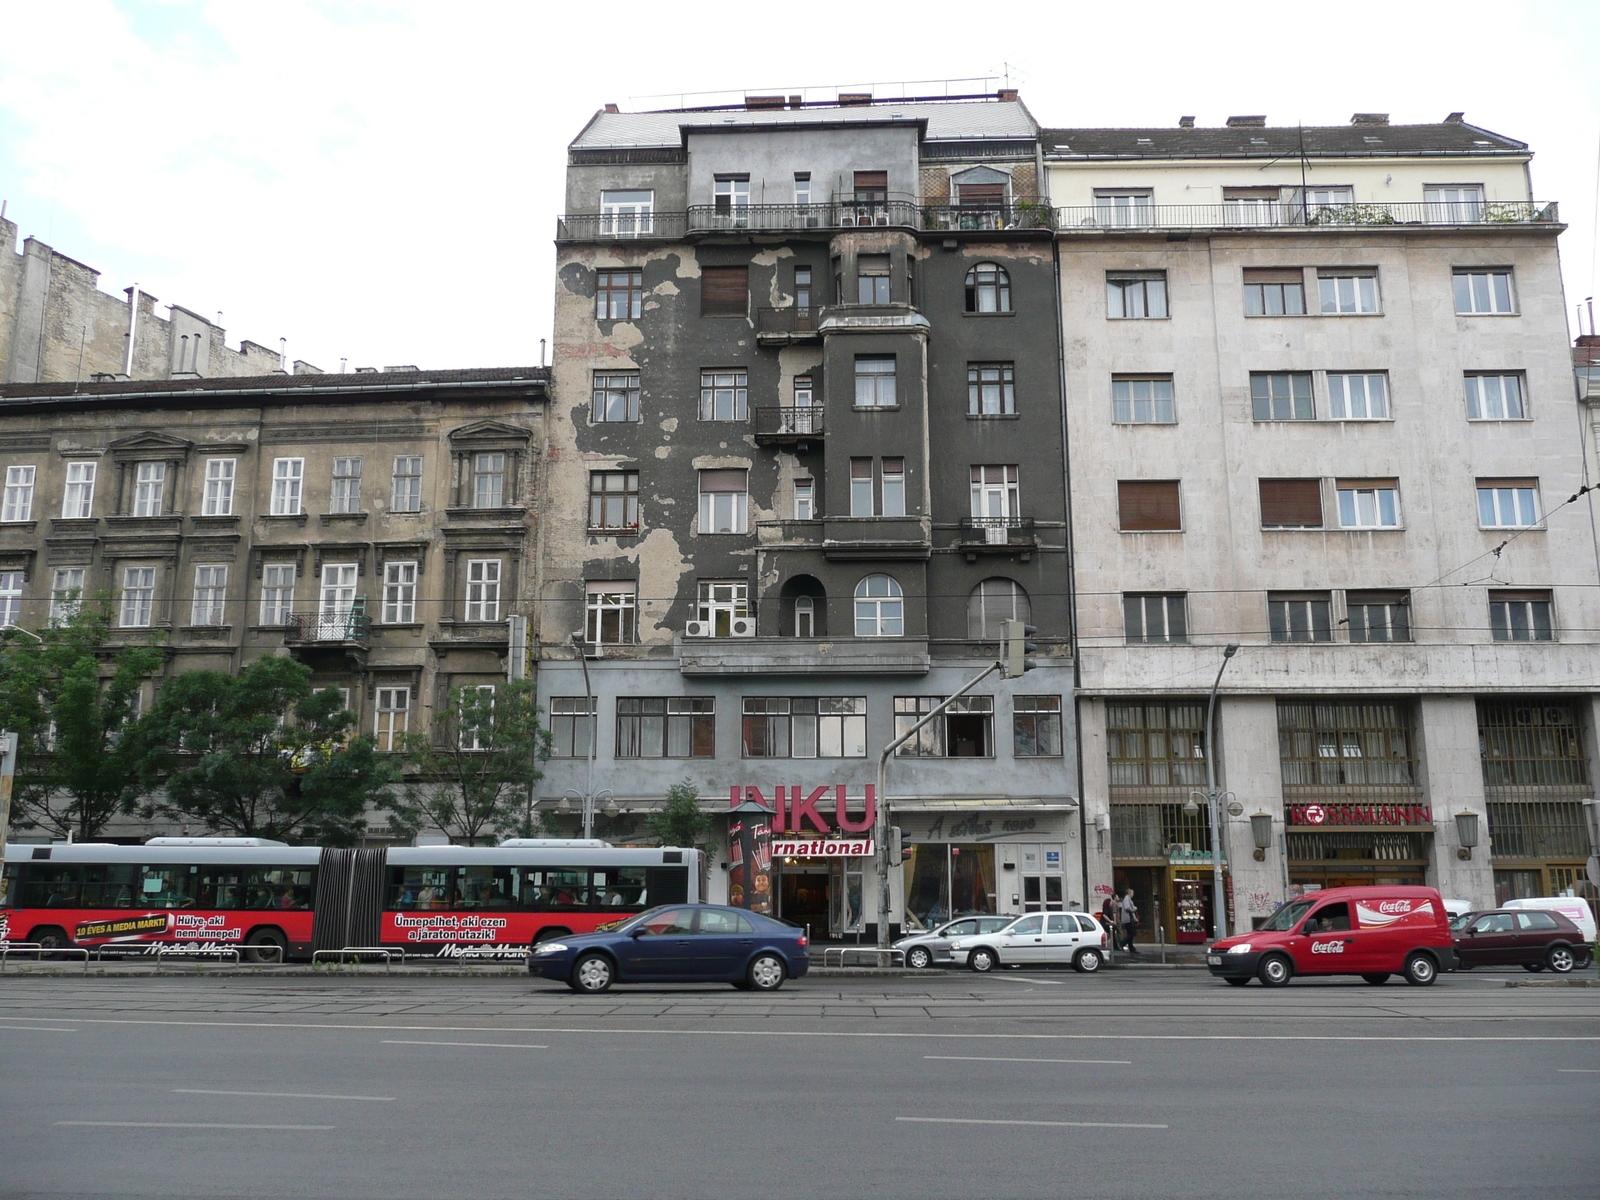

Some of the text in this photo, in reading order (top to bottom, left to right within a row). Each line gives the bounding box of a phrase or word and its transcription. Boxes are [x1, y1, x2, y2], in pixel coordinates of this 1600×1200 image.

[1291, 804, 1433, 825] ROSSMANN
[1171, 850, 1226, 860] ASTORA
[76, 927, 86, 936] 10
[106, 925, 113, 933] A
[113, 922, 136, 932] MEDIA
[137, 918, 165, 930] MARKT!
[177, 914, 225, 928] Hülye, aki
[395, 913, 506, 928] Ünnepelhet, aki ezen
[175, 928, 241, 940] nem ünnepel!
[408, 931, 416, 940] a
[458, 929, 496, 940] utazik!
